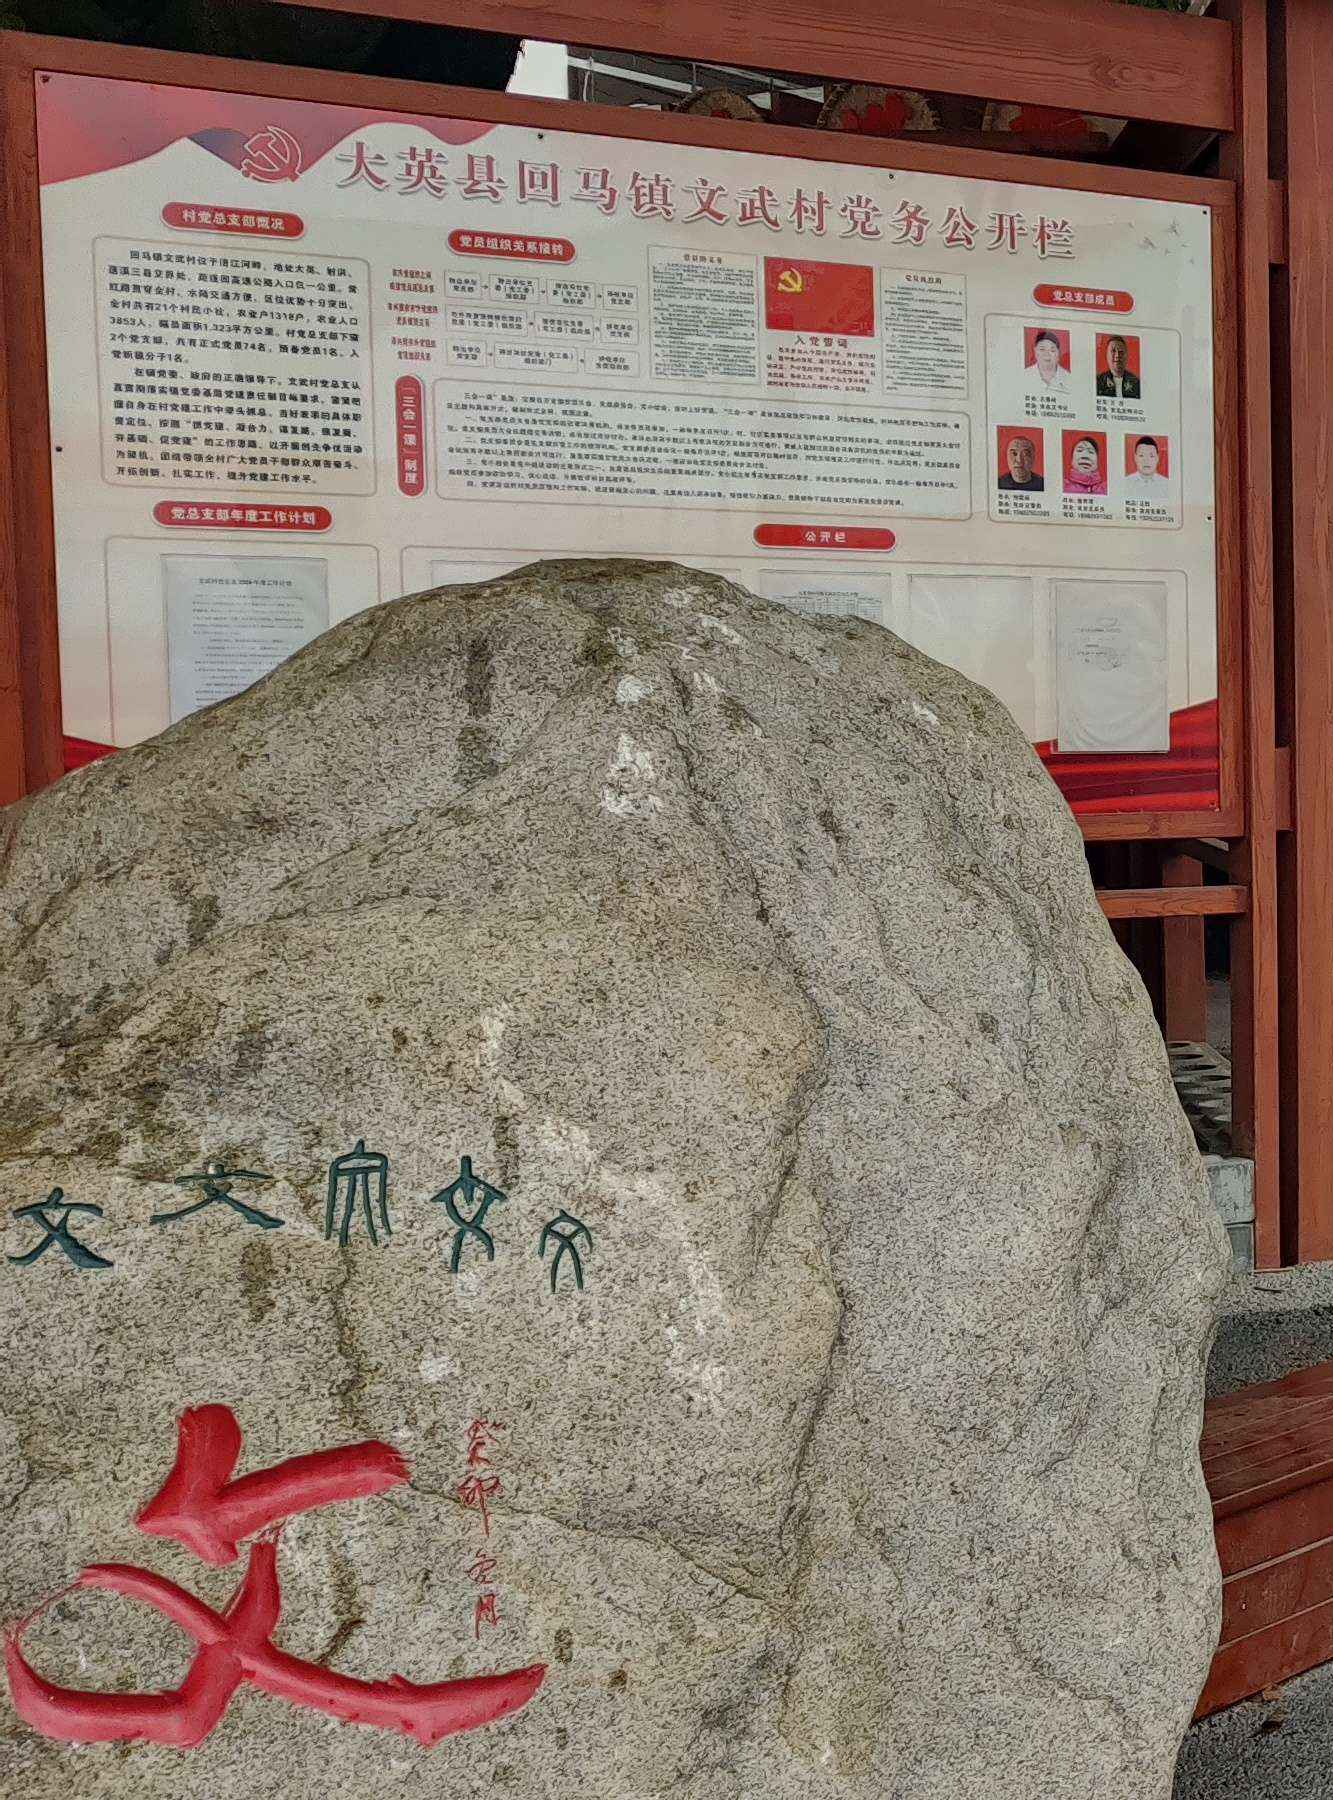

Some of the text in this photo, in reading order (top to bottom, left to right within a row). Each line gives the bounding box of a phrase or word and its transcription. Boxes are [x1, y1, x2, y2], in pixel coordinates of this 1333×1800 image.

[335, 140, 1076, 259] 大英县回马镇文武村党务公开栏
[181, 207, 286, 233] 村党总支部概况
[171, 506, 316, 525] 党总支部年度工作计划
